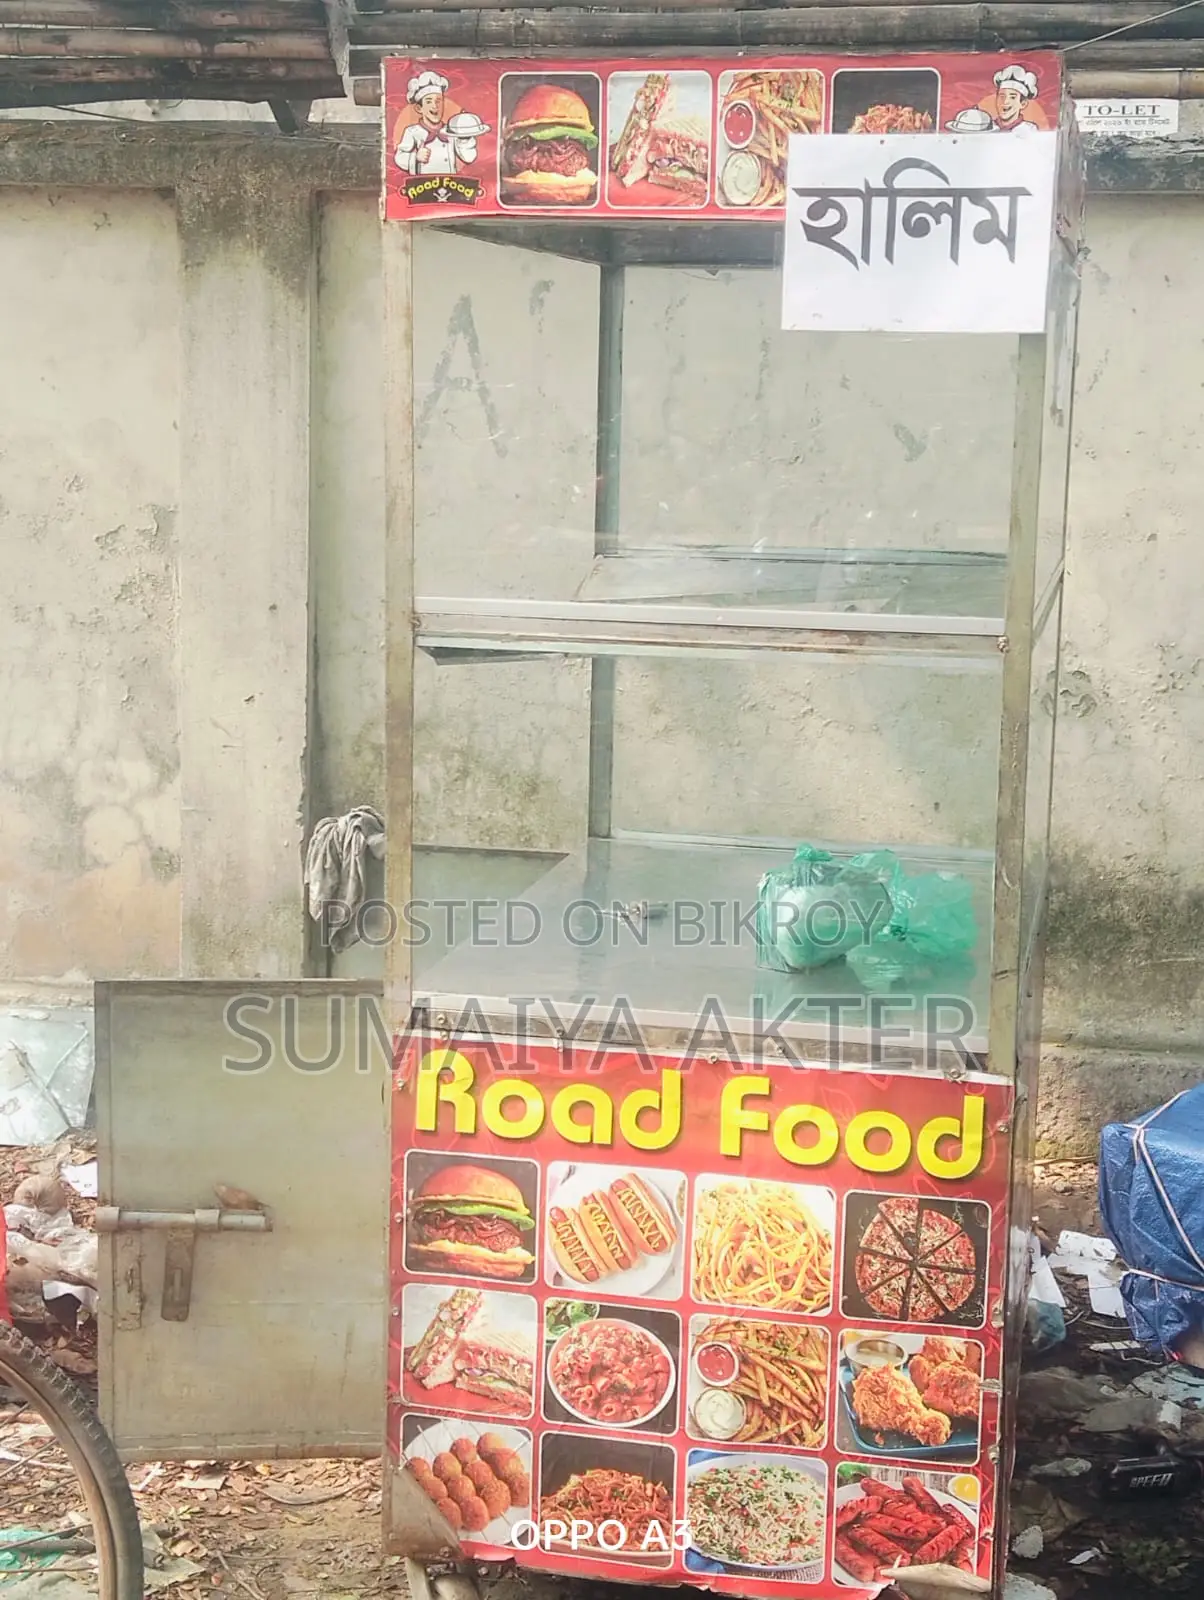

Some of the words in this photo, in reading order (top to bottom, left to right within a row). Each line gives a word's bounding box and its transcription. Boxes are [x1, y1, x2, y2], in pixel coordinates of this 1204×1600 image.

[1083, 104, 1161, 116] TO-LET
[407, 176, 440, 199] Road
[442, 176, 475, 198] Food
[792, 157, 1033, 272] হালিম
[415, 1048, 682, 1150] Road
[719, 1075, 985, 1180] Food
[1129, 1472, 1174, 1488] SPEED
